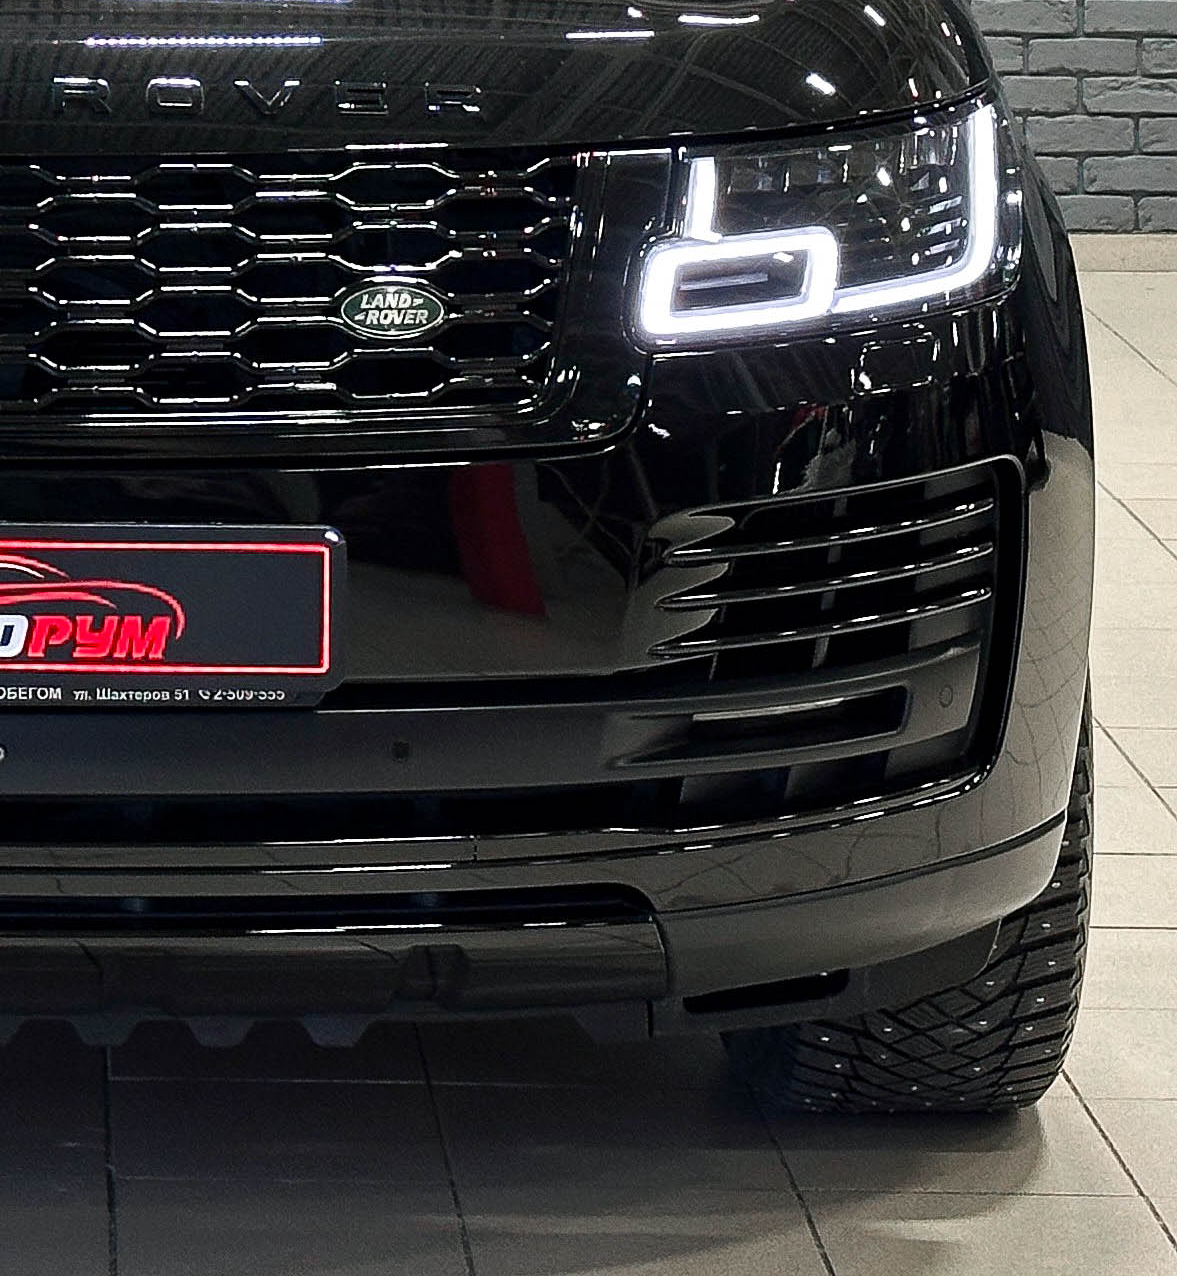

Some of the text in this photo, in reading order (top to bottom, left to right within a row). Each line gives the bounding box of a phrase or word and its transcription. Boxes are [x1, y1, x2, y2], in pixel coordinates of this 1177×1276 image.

[52, 75, 486, 115] ROVER
[360, 293, 413, 310] LAND
[365, 309, 430, 326] ROVER
[173, 688, 190, 701] 51
